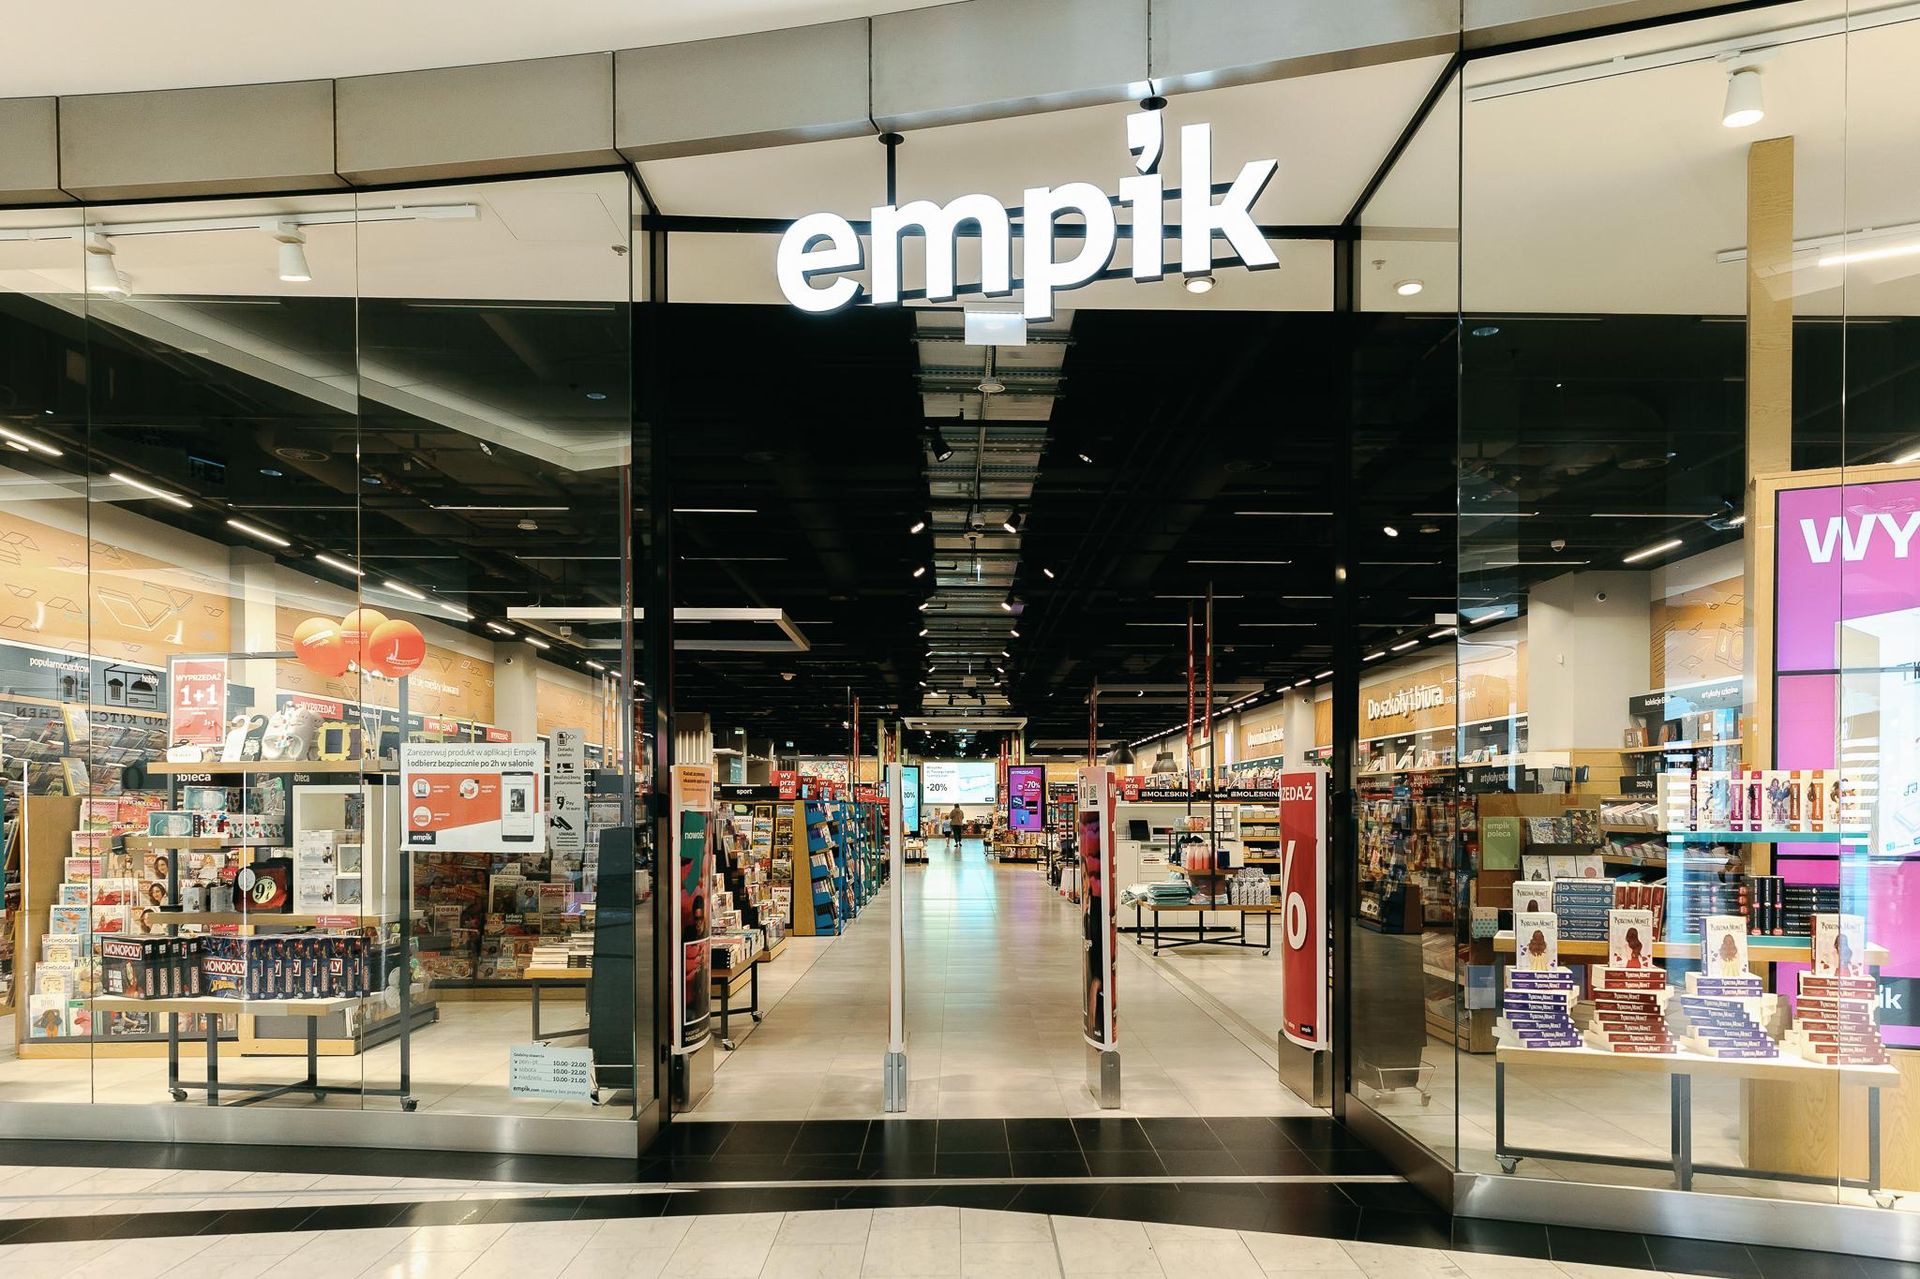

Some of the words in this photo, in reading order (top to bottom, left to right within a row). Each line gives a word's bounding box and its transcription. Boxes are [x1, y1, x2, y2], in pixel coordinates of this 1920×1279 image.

[776, 109, 1280, 322] empik
[141, 673, 160, 686] hobby
[176, 672, 222, 682] WYPRZEDAŻ
[180, 684, 218, 705] 1+1
[407, 748, 447, 758] Zarezerwuj
[448, 748, 475, 758] produkt
[484, 748, 512, 758] aplikacji
[514, 748, 537, 758] Empik
[438, 760, 480, 769] bezpiecznie
[480, 762, 490, 770] po
[926, 784, 948, 792] -20%
[1024, 780, 1041, 789] -70%
[412, 832, 432, 842] empik
[1488, 830, 1511, 838] poleca
[104, 944, 142, 958] MONOPOLY
[203, 959, 245, 974] MONOPOLY
